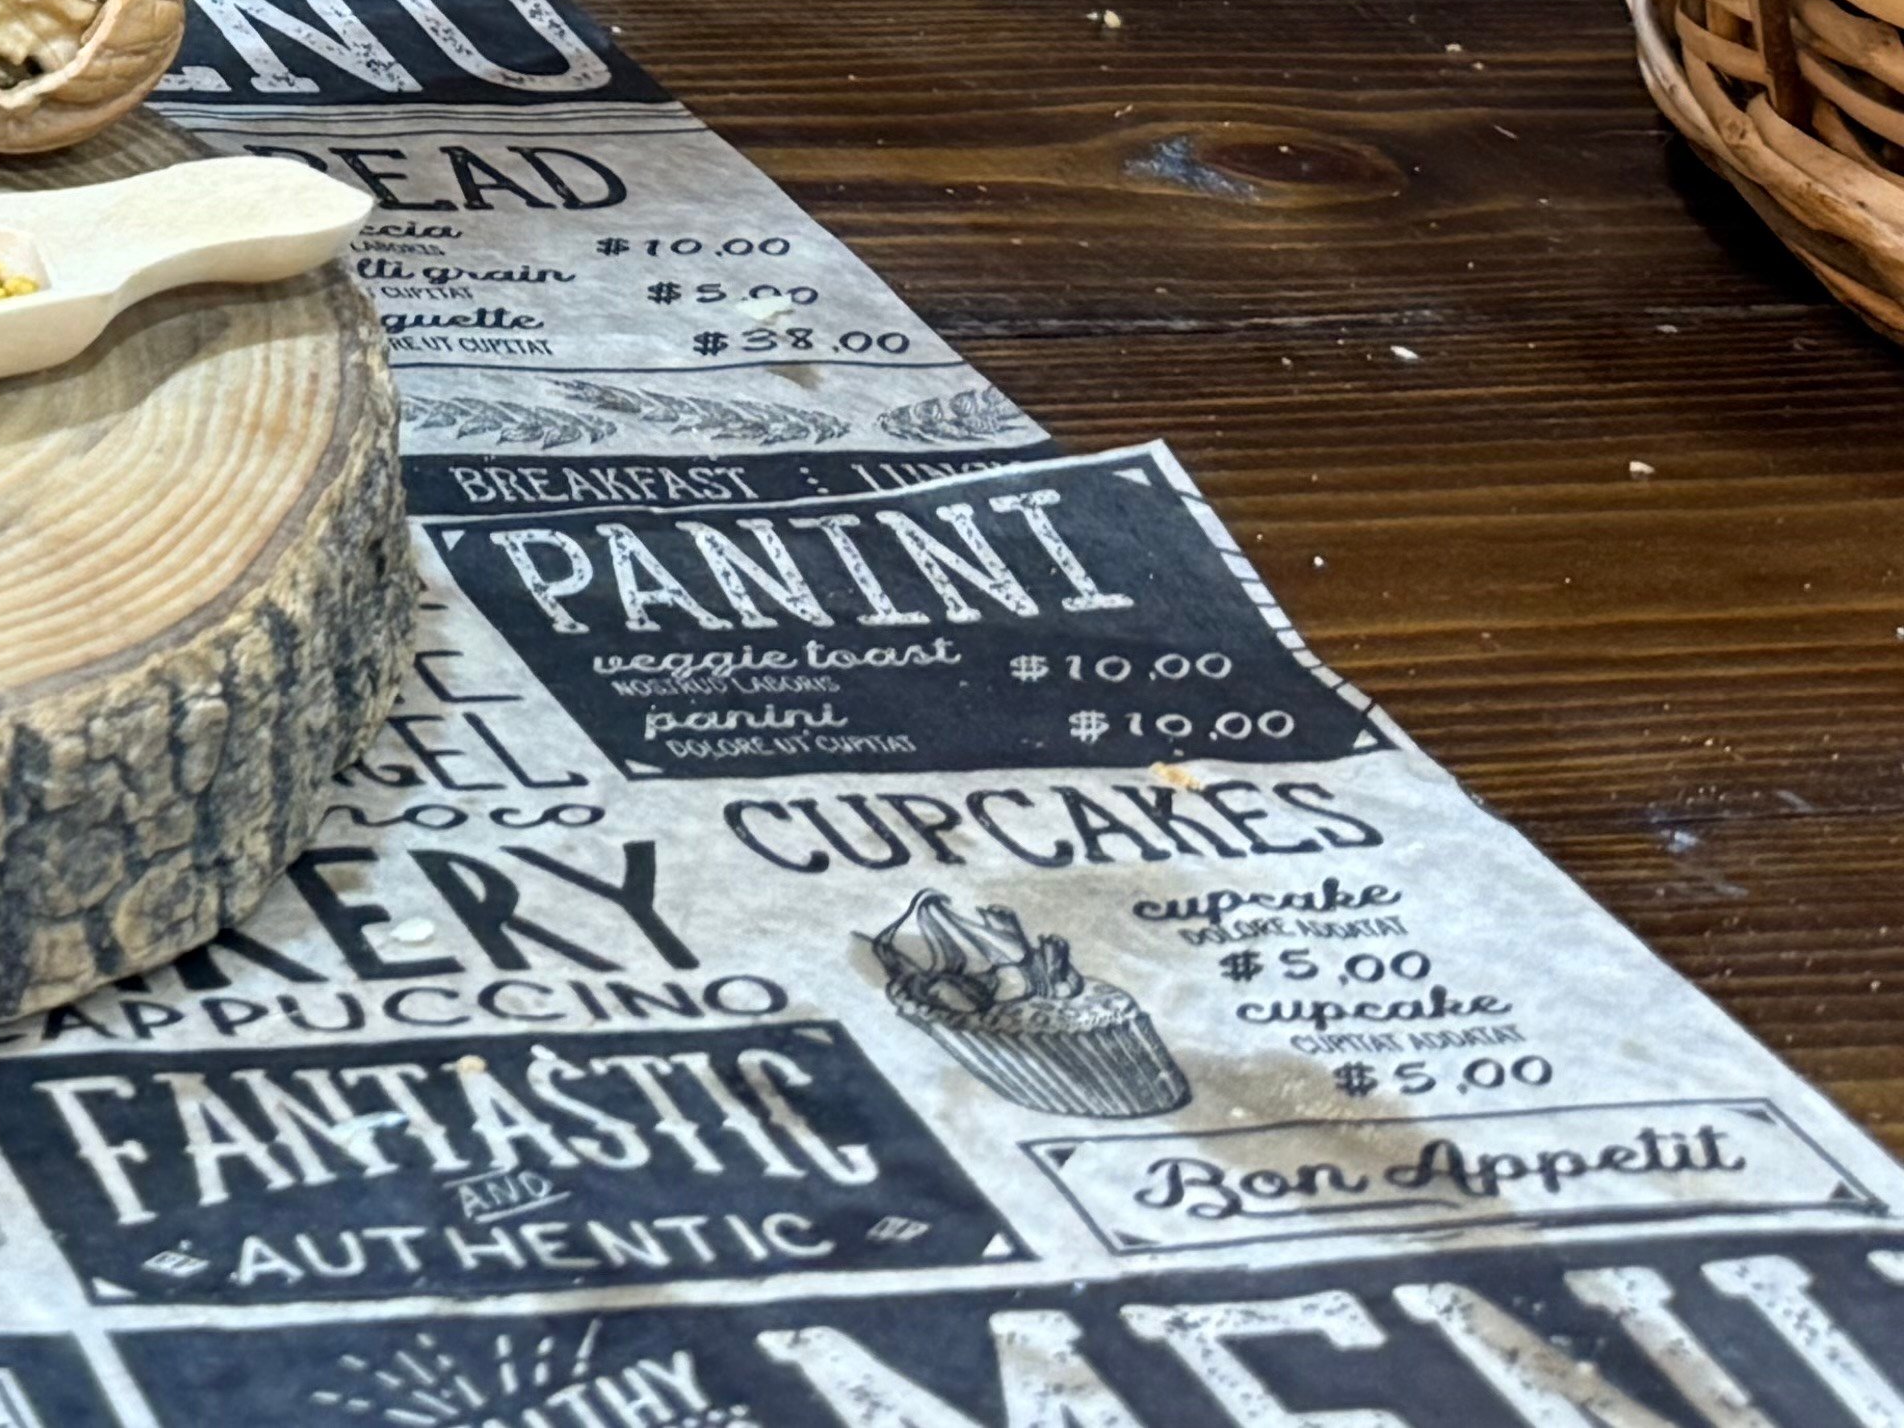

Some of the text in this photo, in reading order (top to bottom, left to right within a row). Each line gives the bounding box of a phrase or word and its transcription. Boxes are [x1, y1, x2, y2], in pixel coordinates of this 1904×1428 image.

[596, 236, 791, 257] $10.00
[422, 265, 576, 285] grain
[693, 327, 910, 356] $38.00
[448, 465, 760, 504] BREAKFAST
[490, 489, 1135, 634] PANINI
[593, 636, 1233, 682] veggie toast $10.00
[644, 702, 1295, 741] panini $10.00
[665, 736, 774, 758] DOLORE
[722, 779, 1385, 873] CUPCAKES
[1132, 877, 1402, 924] cupcake
[1235, 984, 1513, 1032] cupcake
[1332, 1054, 1554, 1098] $5.00
[34, 1046, 879, 1225] FANTASTIC
[1133, 1124, 1747, 1217] Bon Appetit
[450, 1172, 557, 1216] AND
[234, 1212, 837, 1286] AUTHENTIC
